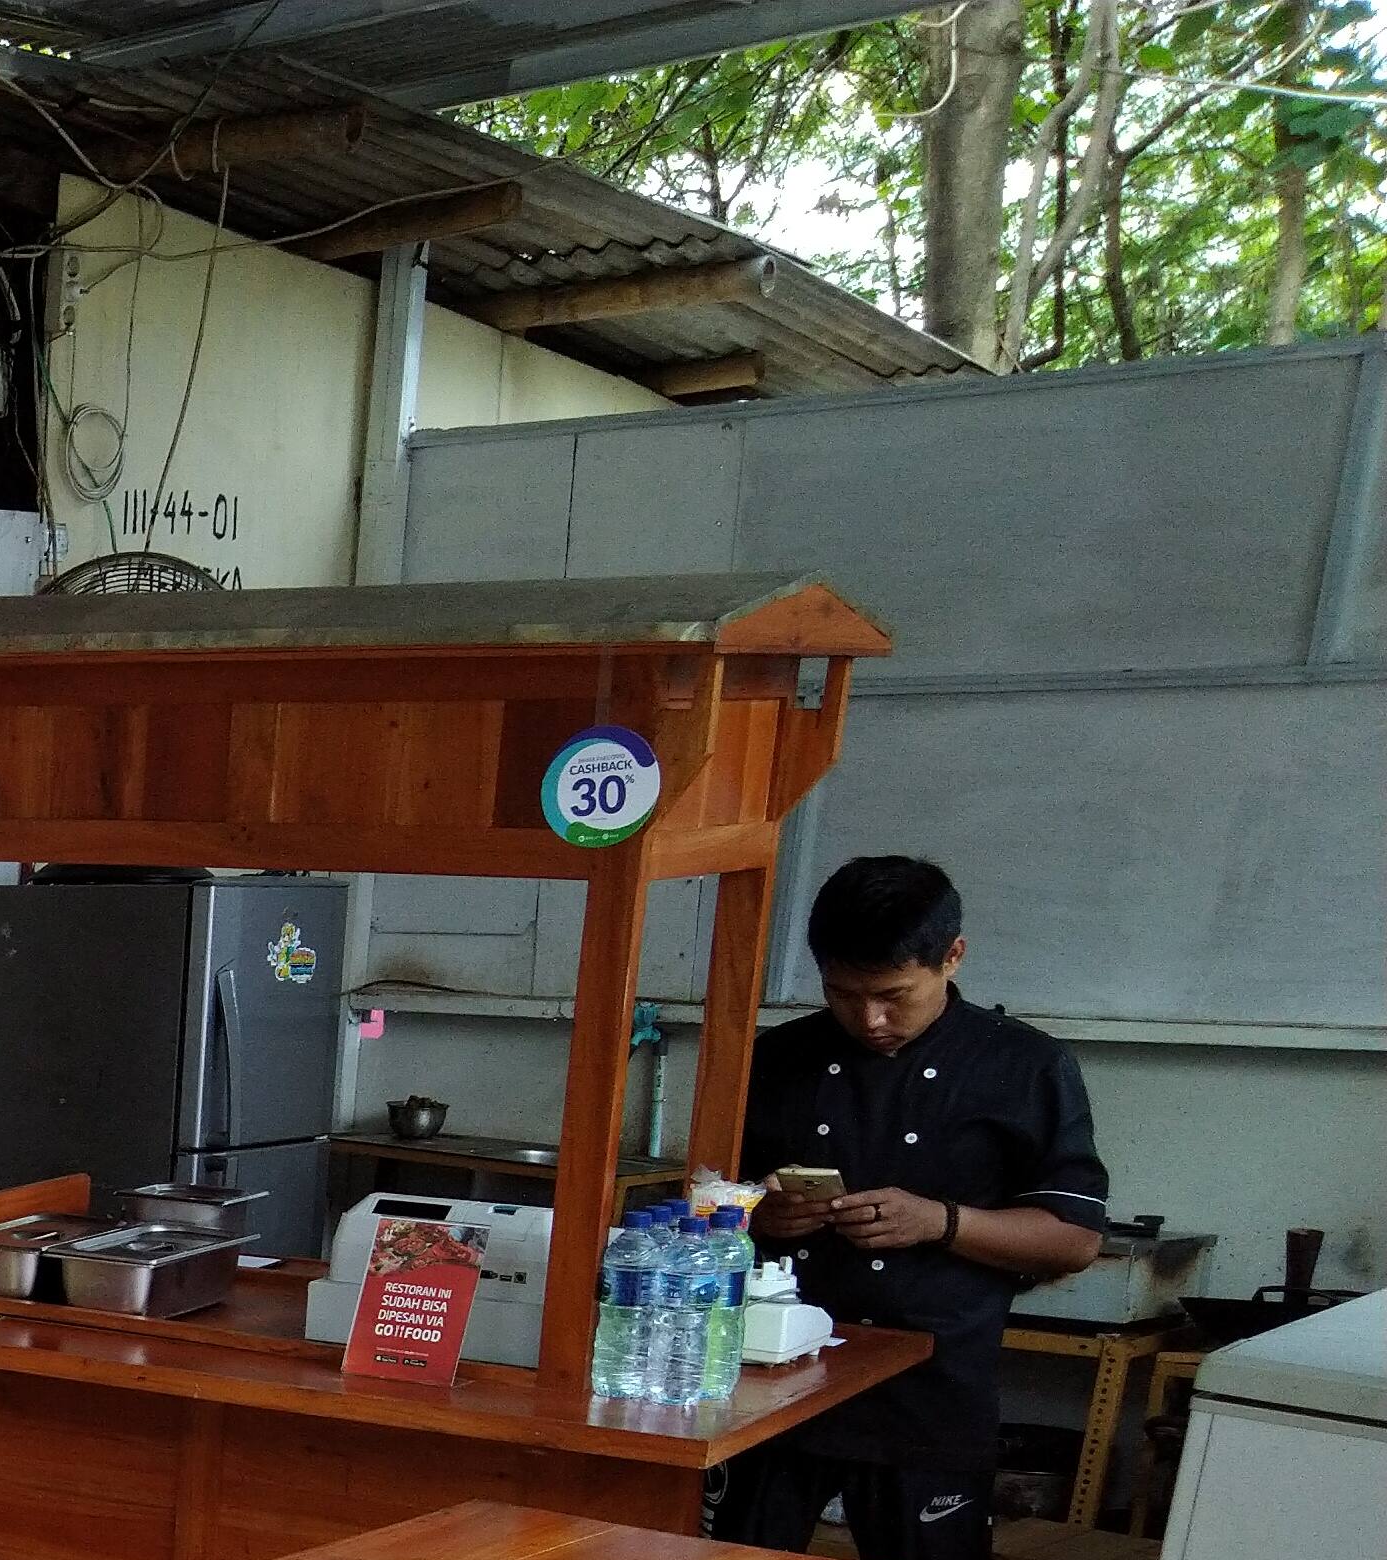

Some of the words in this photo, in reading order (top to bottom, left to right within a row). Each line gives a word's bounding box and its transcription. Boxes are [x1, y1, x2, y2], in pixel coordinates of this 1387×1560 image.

[569, 759, 633, 777] CASHBACK
[384, 1281, 437, 1298] RESTORAN
[437, 1288, 452, 1300] INI
[381, 1294, 422, 1310] SUDAH
[421, 1300, 448, 1313] BISA
[377, 1309, 425, 1325] DIPESAN
[426, 1314, 444, 1328] VIA
[930, 1494, 963, 1506] NIKE
